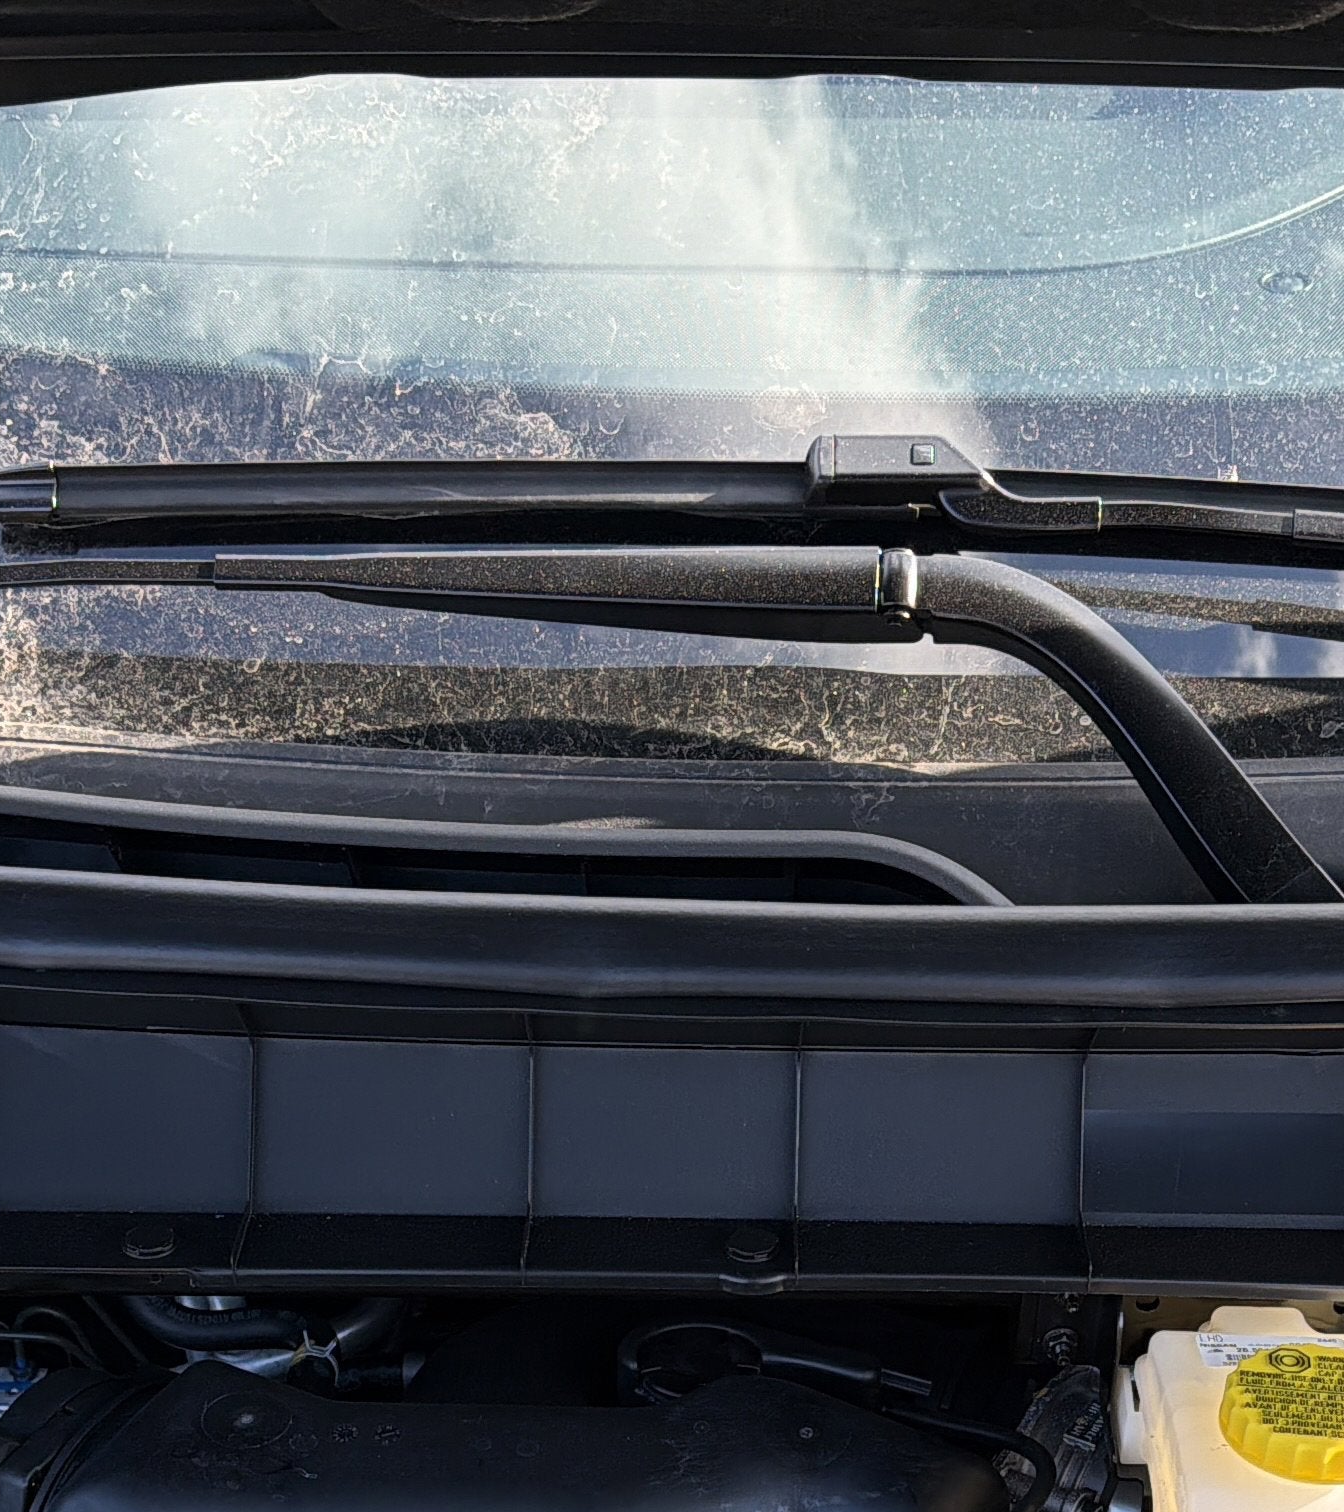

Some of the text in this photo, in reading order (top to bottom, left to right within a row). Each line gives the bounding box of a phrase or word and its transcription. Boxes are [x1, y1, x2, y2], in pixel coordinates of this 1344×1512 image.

[1269, 1380, 1296, 1388] FROM
[1244, 1402, 1277, 1411] AVANT
[1262, 1417, 1280, 1425] DOT
[1272, 1426, 1328, 1437] CONTENANT
